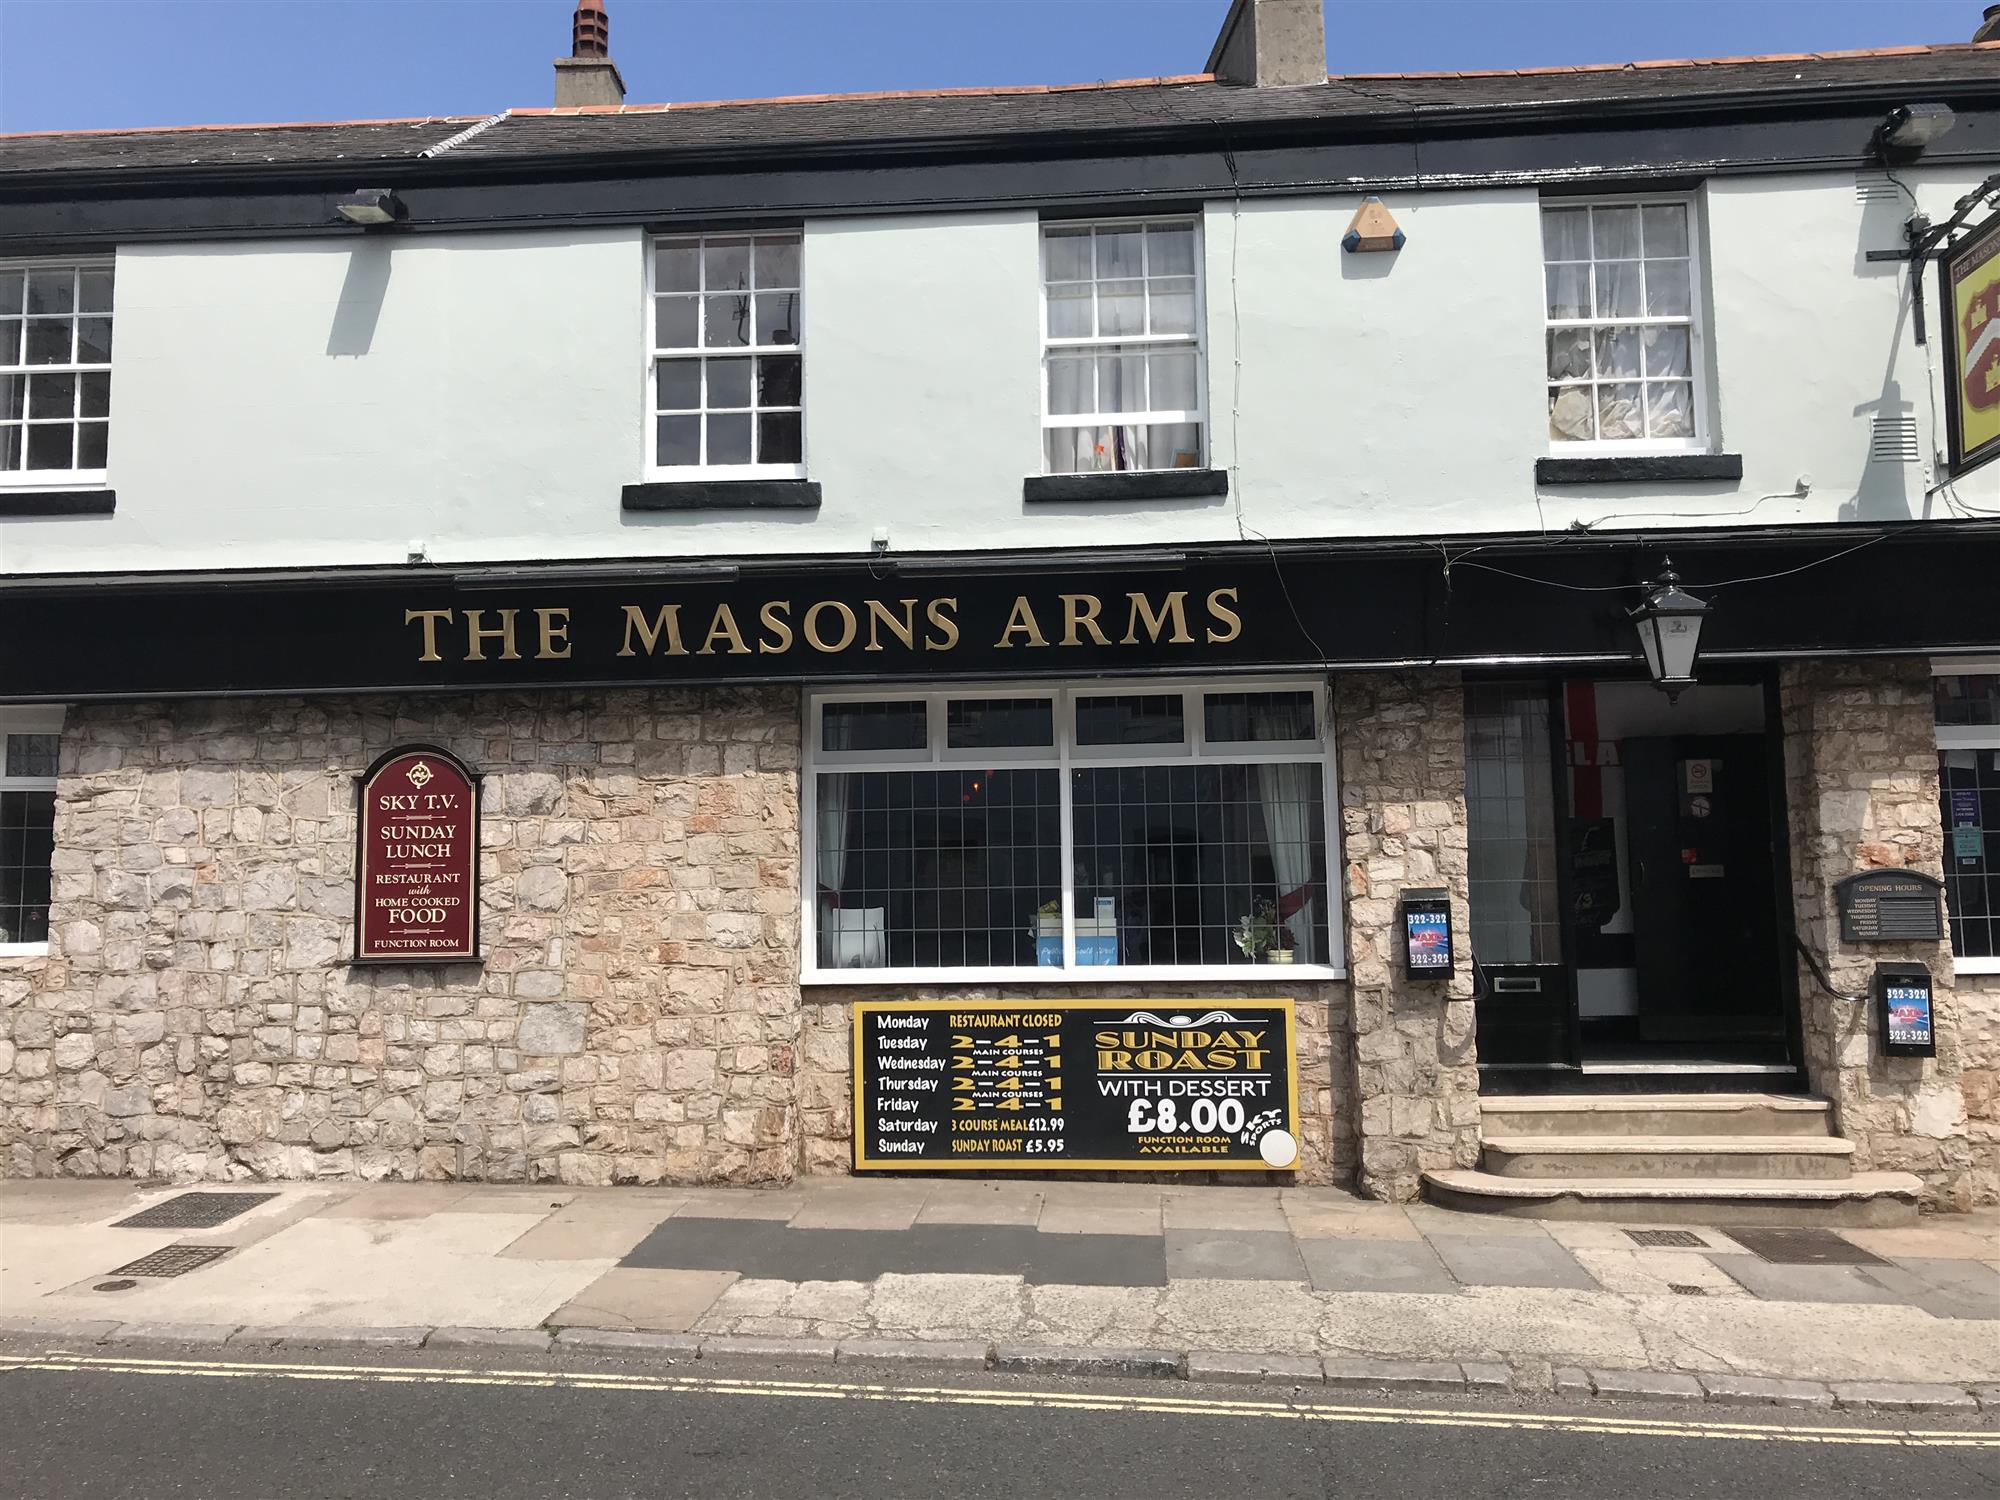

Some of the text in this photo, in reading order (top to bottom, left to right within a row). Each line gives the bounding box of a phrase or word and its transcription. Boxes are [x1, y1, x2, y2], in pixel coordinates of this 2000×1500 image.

[405, 587, 1243, 662] THE MASONS ARMS
[379, 794, 459, 810] SKY T.V.
[380, 825, 457, 840] SUNDAY
[386, 844, 451, 859] LUNCH
[376, 874, 460, 884] RESTAURANT
[408, 885, 431, 896] with
[1895, 884, 1922, 892] HOURS
[375, 897, 460, 907] HOME COOKED
[388, 908, 446, 924] FOOD
[1408, 914, 1447, 924] 322-322
[374, 939, 459, 948] FUNCTION ROOM
[1410, 954, 1449, 964] 322-322
[1887, 988, 1926, 1000] 322-322
[877, 1014, 1062, 1030] Monday RESTAURANT CLOSED
[877, 1034, 1061, 1050] Tuesday 2-4-1
[1095, 1030, 1266, 1049] SUNDAY
[1889, 1030, 1929, 1040] 322-322
[878, 1055, 1061, 1071] Wednesday 2-4-1
[1097, 1050, 1271, 1070] ROAST
[878, 1076, 1062, 1092] Thursday 2-4-1
[1098, 1080, 1271, 1096] WITH DESSERT
[877, 1097, 1062, 1113] Friday 2-4-1
[1127, 1098, 1245, 1134] £8.00
[878, 1118, 1064, 1133] Saturday 3 COURSE MEAL £12.99
[1240, 1108, 1282, 1144] SKY
[1249, 1118, 1282, 1146] SPORTS
[878, 1139, 1064, 1154] Sunday SUNDAY ROAST £5.95
[1138, 1136, 1231, 1144] FUNCTION ROOM
